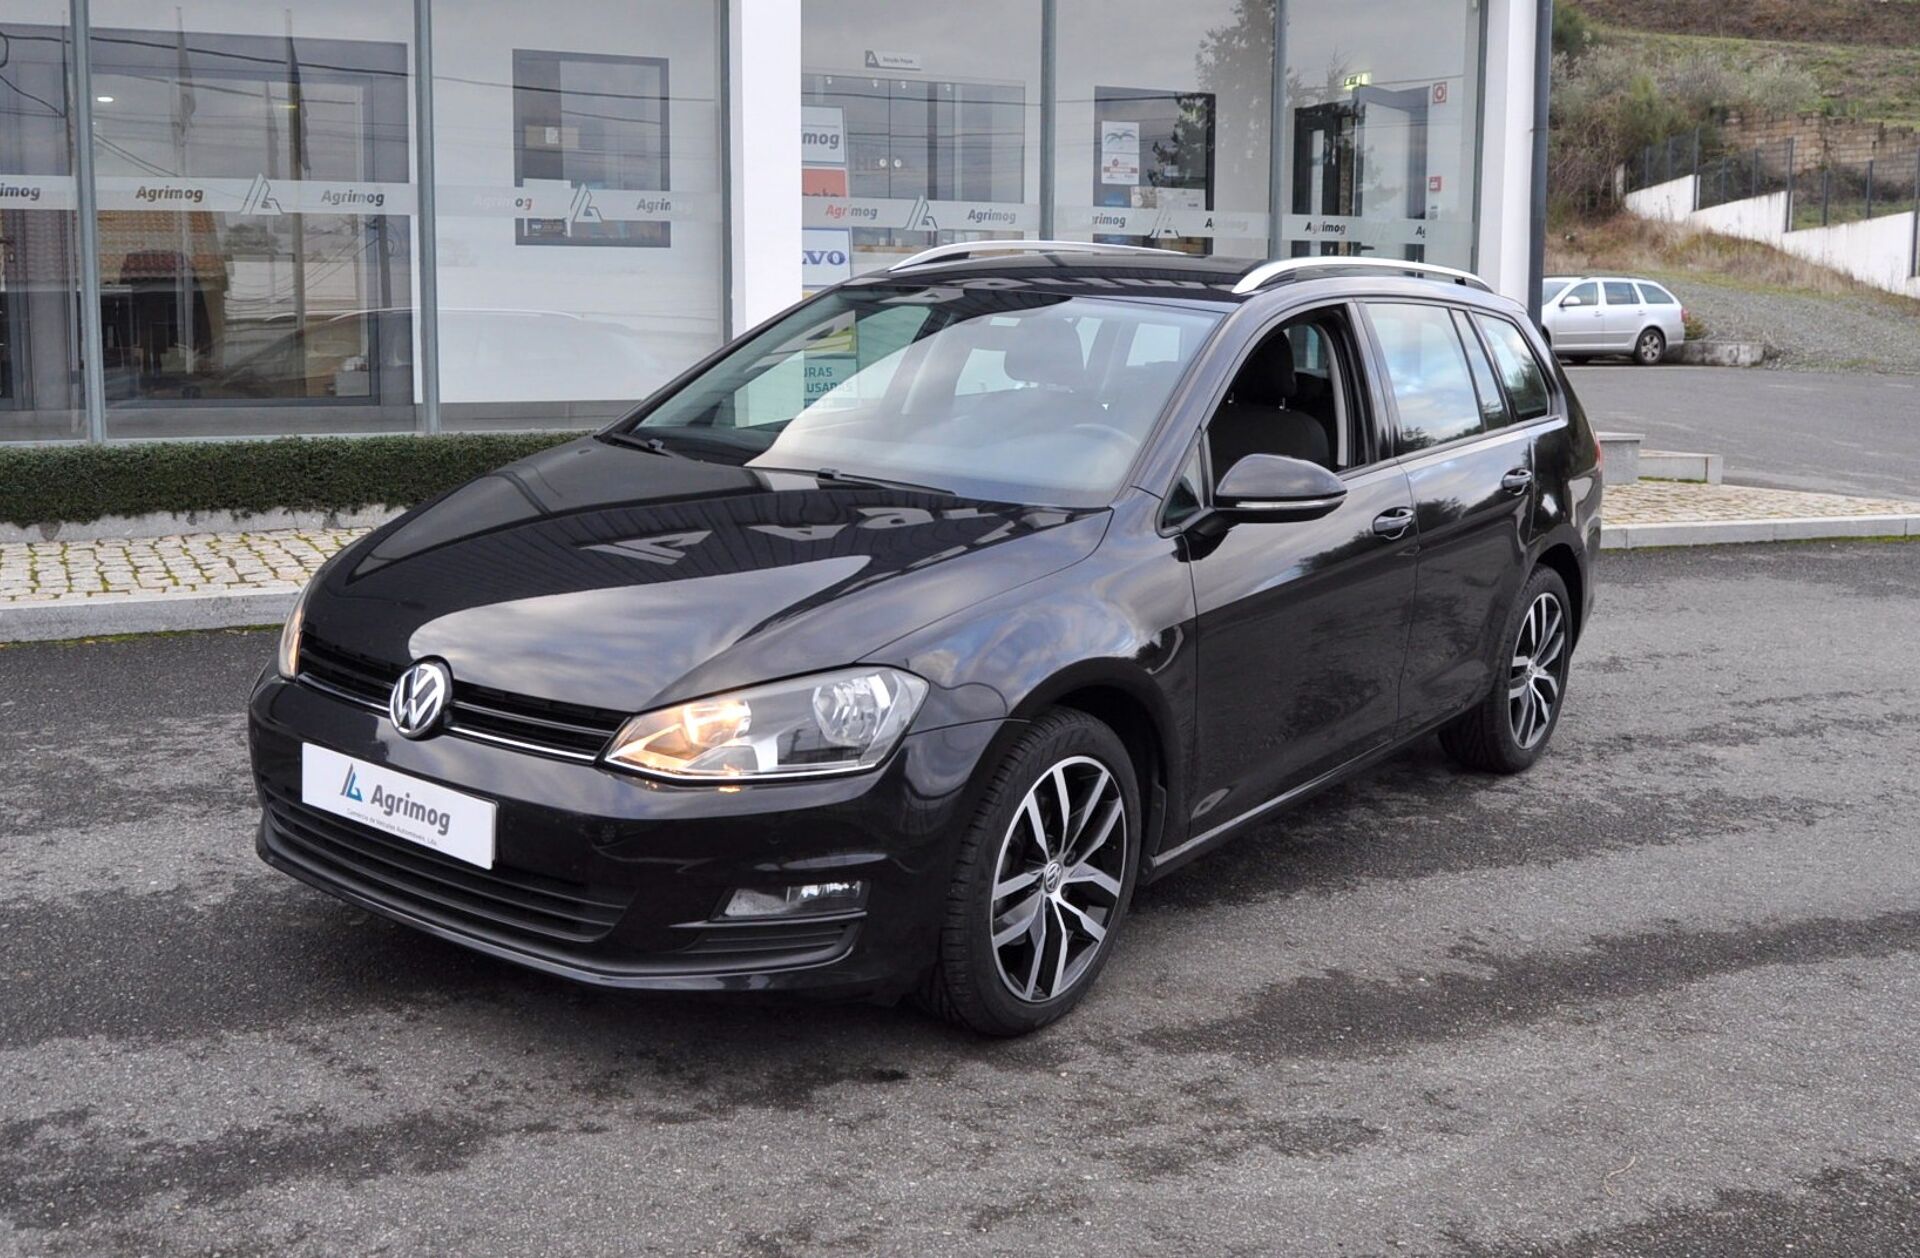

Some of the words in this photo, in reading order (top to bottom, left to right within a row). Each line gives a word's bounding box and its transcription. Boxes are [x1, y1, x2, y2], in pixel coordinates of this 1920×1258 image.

[136, 185, 204, 203] Agrimog
[321, 188, 385, 206] Agrimog
[825, 203, 878, 221] Agrimog
[967, 207, 1017, 225] Agrimog
[1305, 221, 1346, 236] Agrimog
[370, 784, 451, 836] Agrimog
